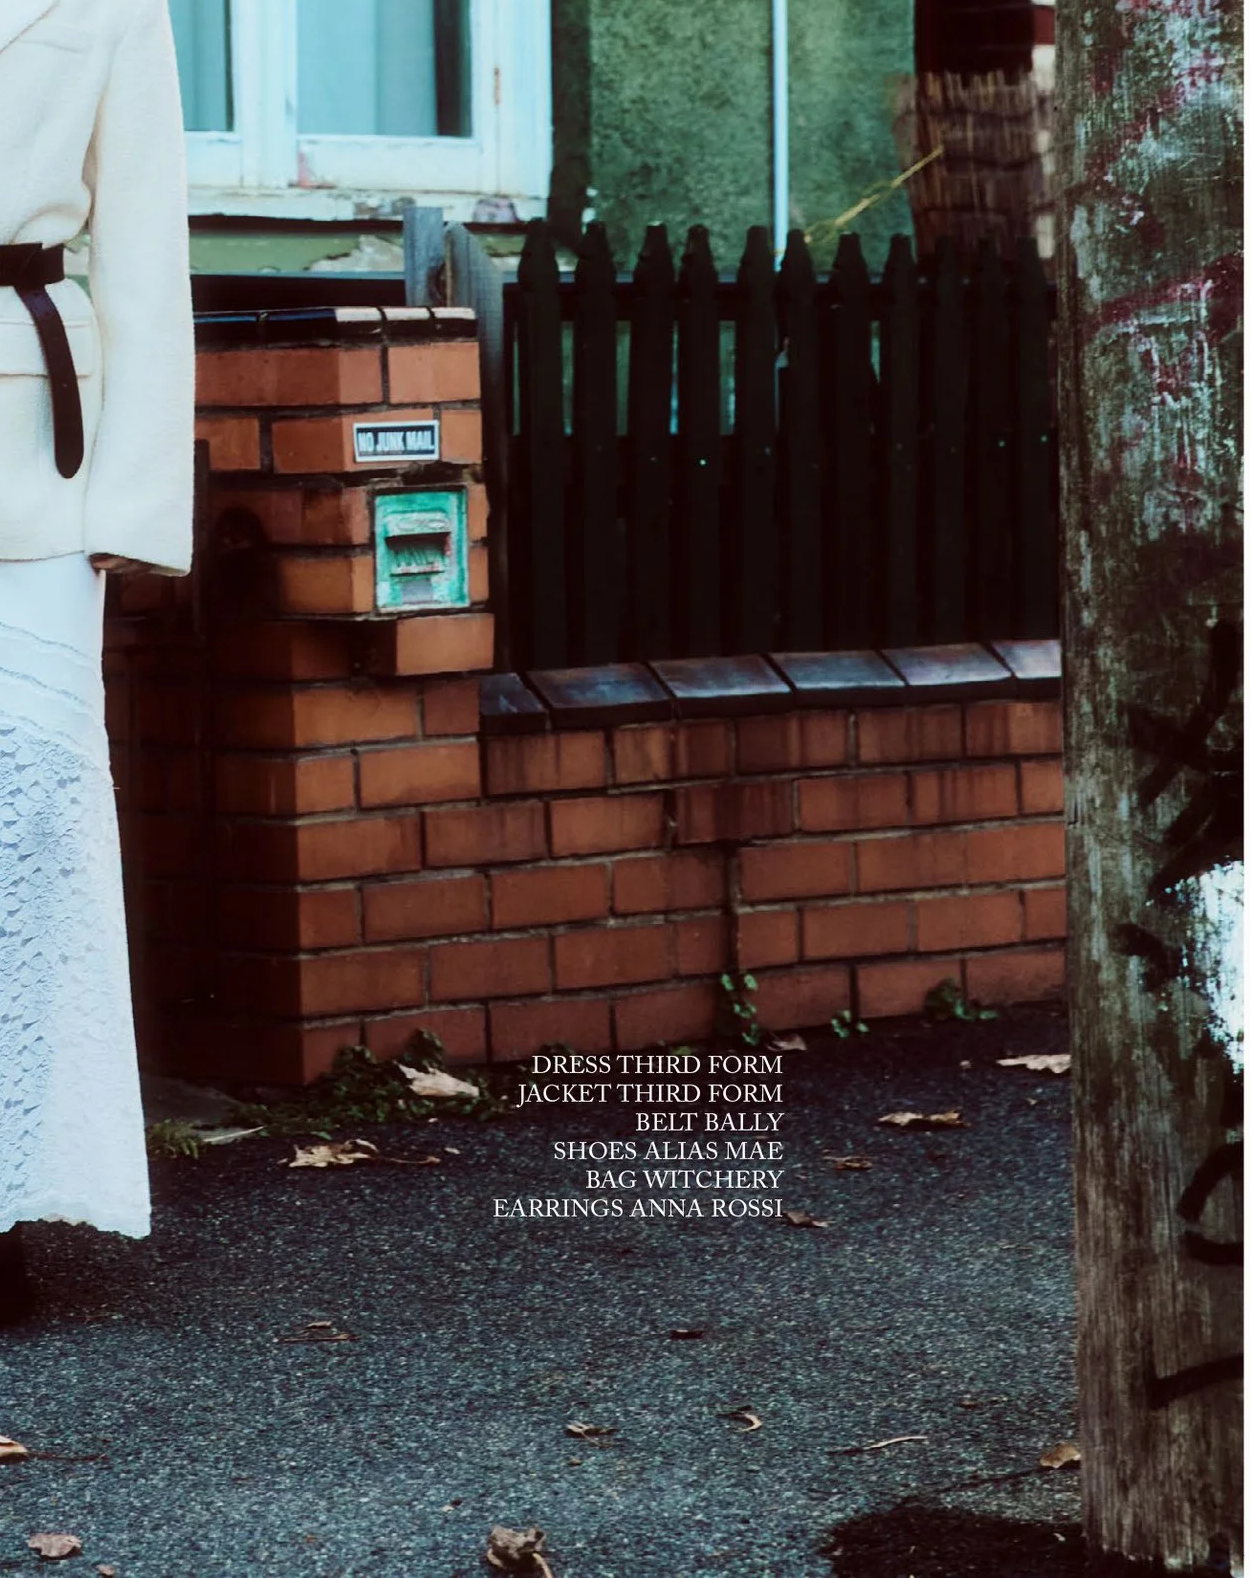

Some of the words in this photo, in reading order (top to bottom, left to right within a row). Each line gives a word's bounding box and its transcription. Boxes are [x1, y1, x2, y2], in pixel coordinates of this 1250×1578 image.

[357, 431, 375, 452] NO
[376, 431, 404, 451] JUNK
[406, 430, 435, 450] MAIL
